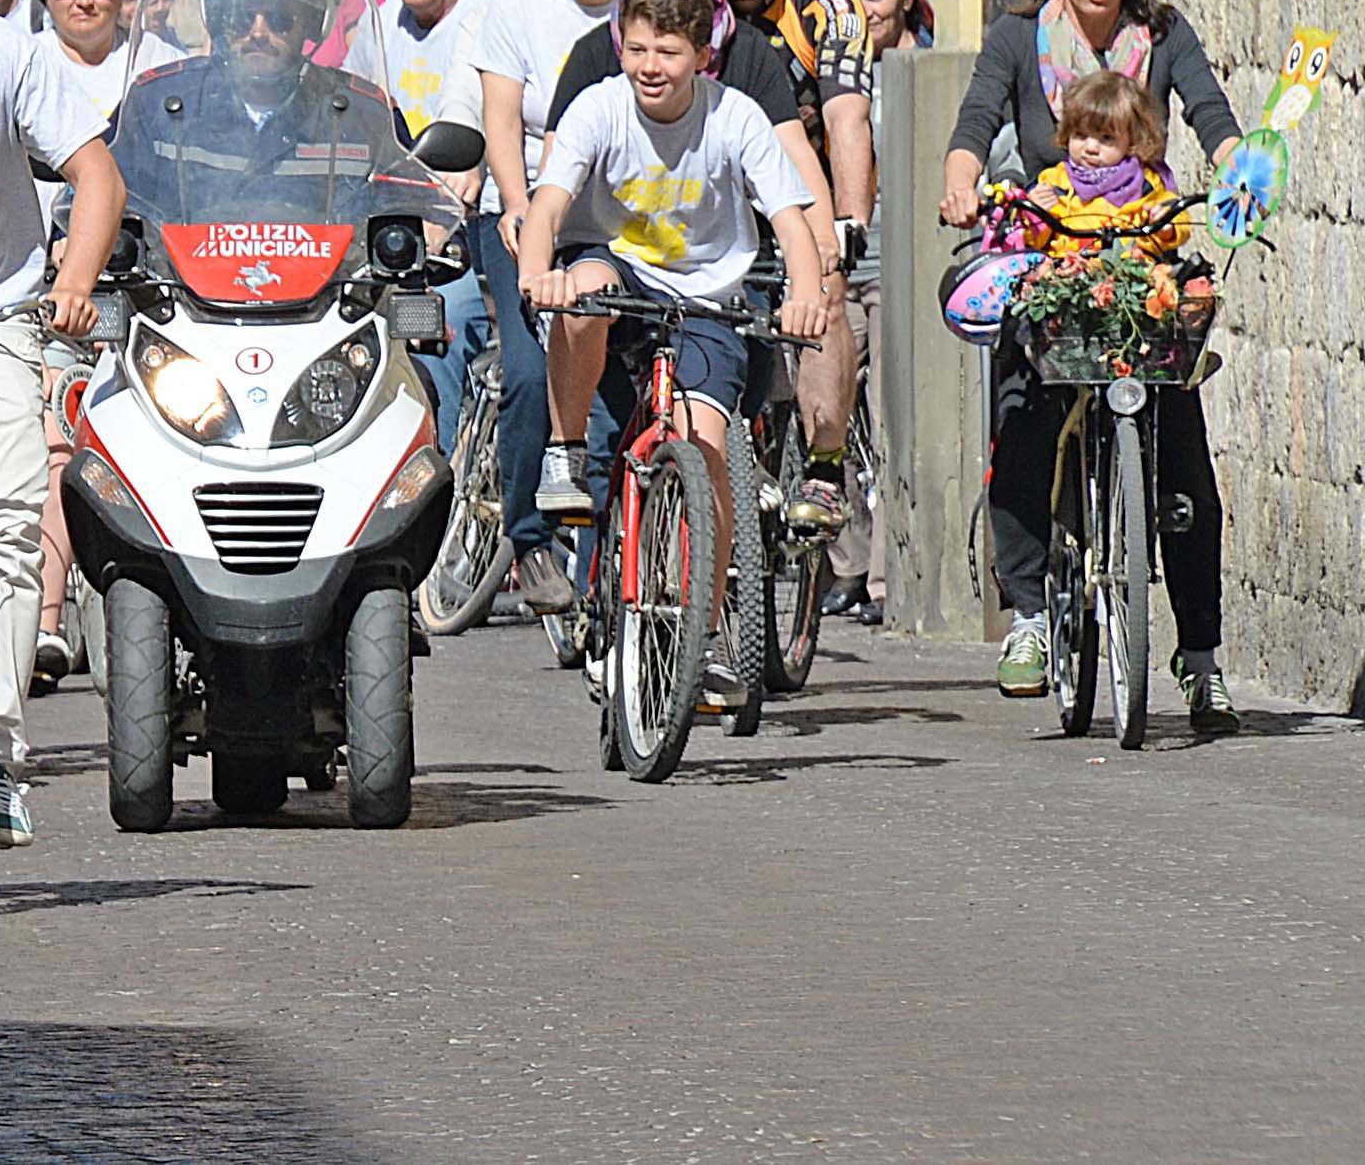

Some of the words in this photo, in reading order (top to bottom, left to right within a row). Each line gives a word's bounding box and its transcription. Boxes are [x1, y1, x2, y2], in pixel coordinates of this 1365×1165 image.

[209, 224, 313, 241] POLIZIA
[192, 240, 332, 258] MUNICIPALE
[248, 353, 259, 368] 1
